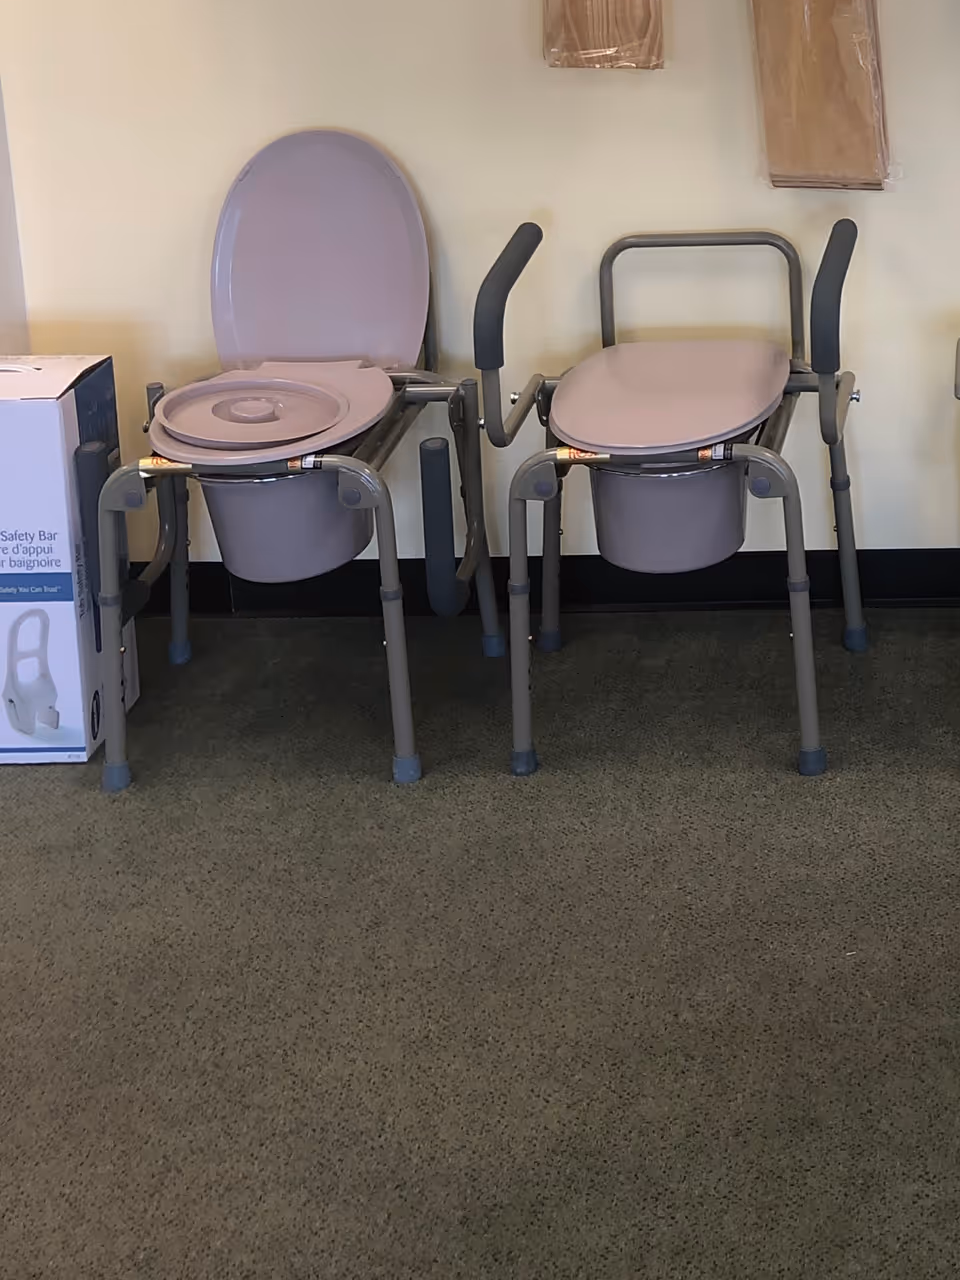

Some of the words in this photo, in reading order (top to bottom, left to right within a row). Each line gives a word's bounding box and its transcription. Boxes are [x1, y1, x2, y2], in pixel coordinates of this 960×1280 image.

[0, 530, 35, 545] Safety
[38, 530, 58, 542] Bar
[12, 543, 53, 558] d'appui
[8, 556, 62, 571] baignoire
